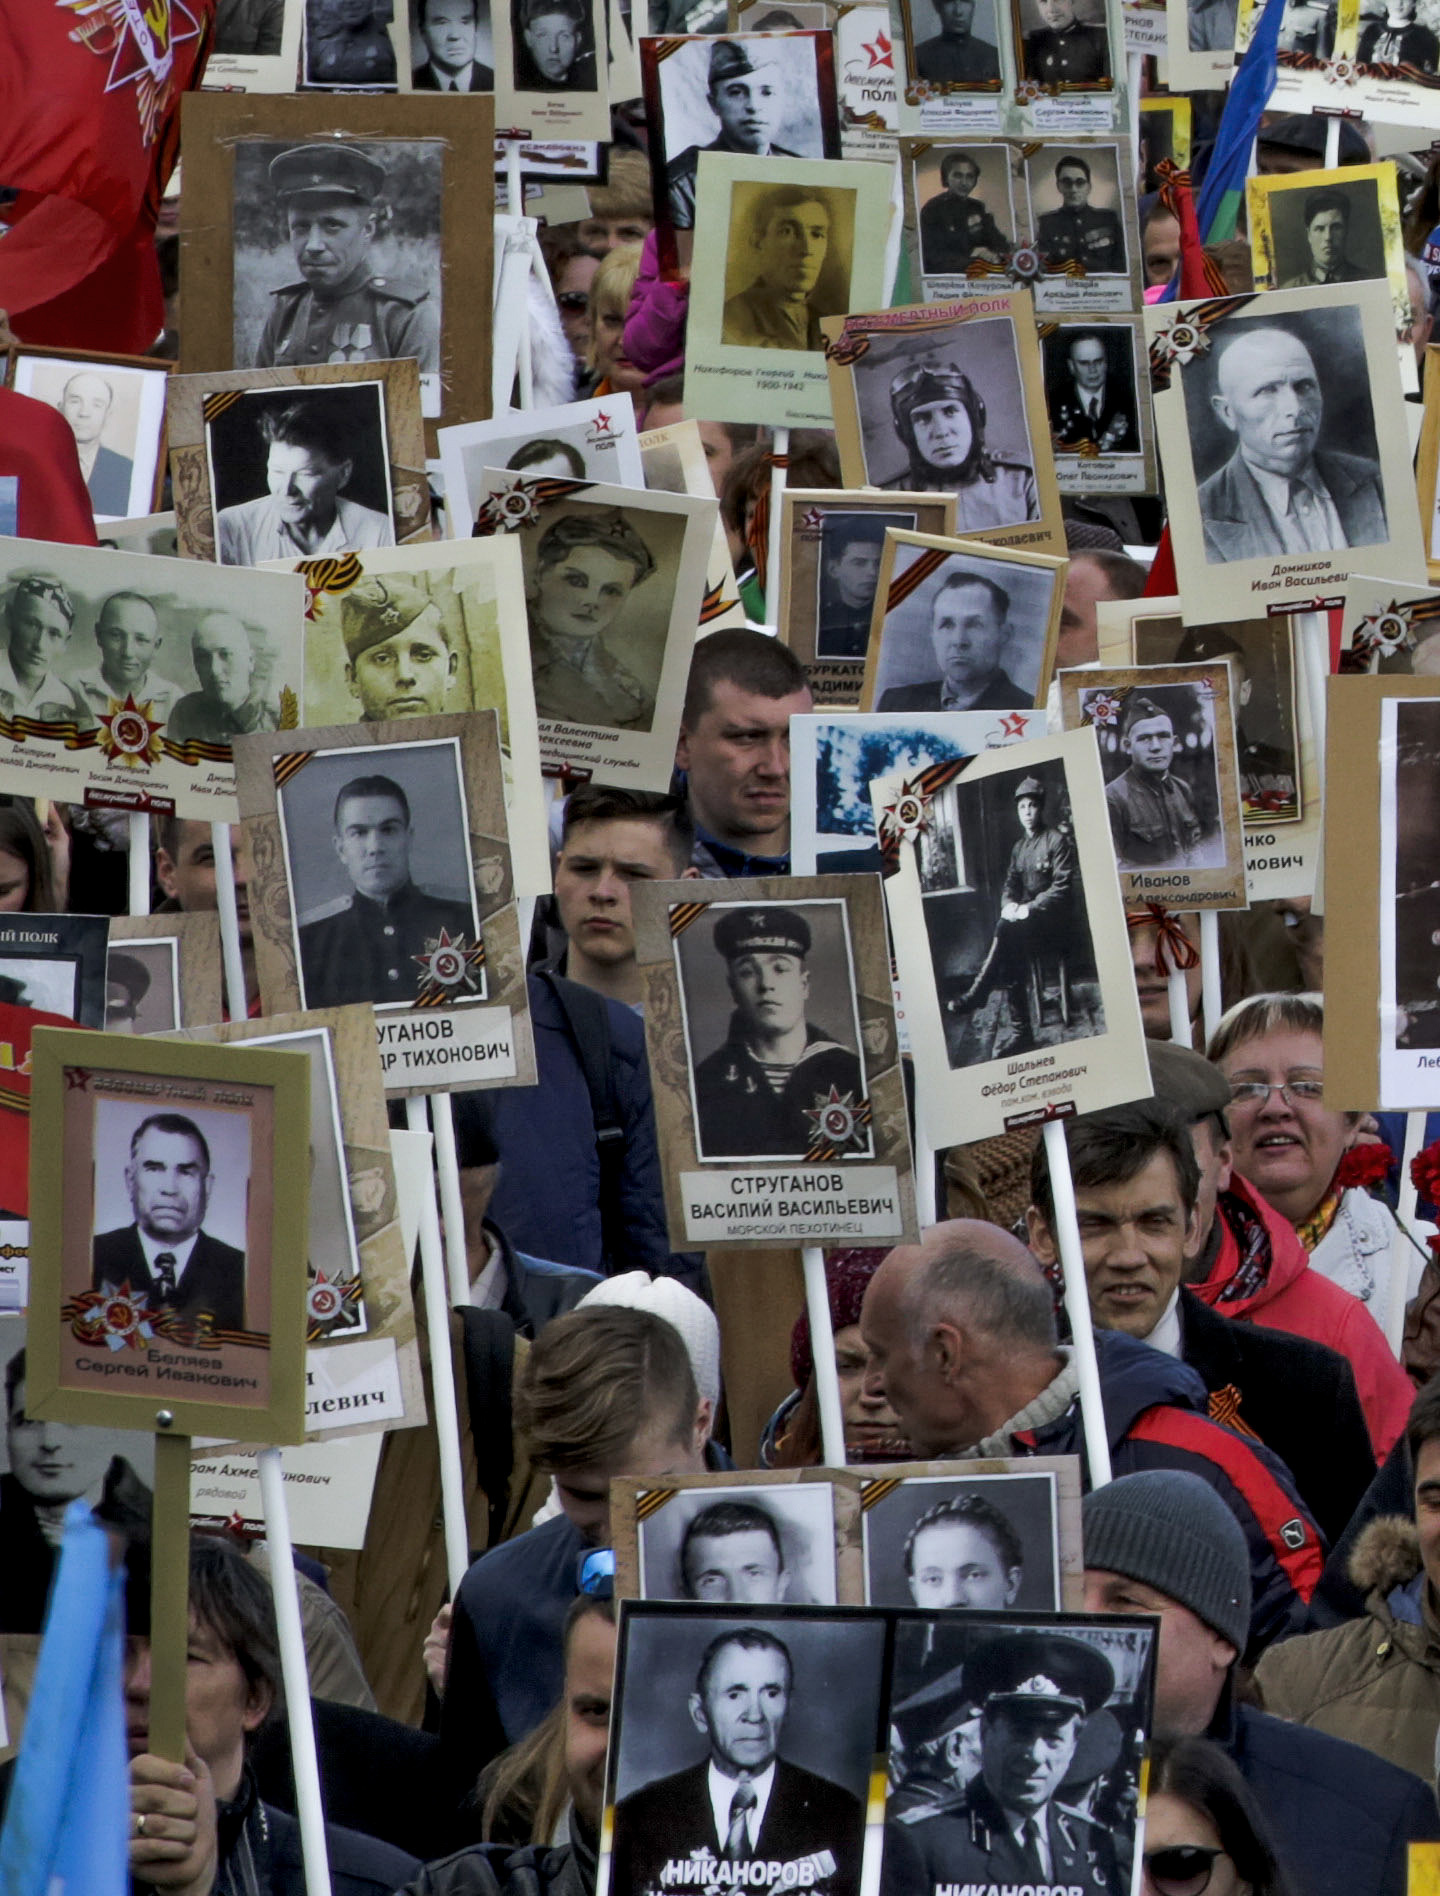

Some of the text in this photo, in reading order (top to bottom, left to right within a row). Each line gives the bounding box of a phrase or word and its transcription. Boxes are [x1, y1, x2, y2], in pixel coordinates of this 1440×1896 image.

[968, 298, 1012, 315] ПОЛК
[756, 366, 797, 379] Георгий
[755, 379, 806, 392] 1900-1942
[1271, 559, 1333, 578] Домников
[1251, 571, 1351, 592] Иван Васильеви
[553, 724, 620, 742] Валентина
[1130, 873, 1192, 888] Иванов
[1135, 889, 1236, 906] Александрович
[18, 930, 59, 944] ПОЛК
[376, 1019, 454, 1043] УГАНОВ
[403, 1042, 511, 1067] ТИХОНОВИЧ
[1006, 1054, 1056, 1078] Шальнев
[980, 1063, 1088, 1099] Фёдор Степанович
[730, 1173, 844, 1195] СТРУГАНОВ
[690, 1196, 895, 1219] ВАСИЛИЙ ВАСИЛЬЕВИЧ
[726, 1221, 864, 1237] МОРСКОЙ ПЕХОТИНЕЦ
[145, 1348, 224, 1372] Беляев
[74, 1356, 258, 1392] Сергей Иванович
[195, 1486, 246, 1501] рядовой
[665, 1858, 815, 1889] НИКАНОРОВ
[935, 1882, 1084, 1896] НИКАНОРОВ
